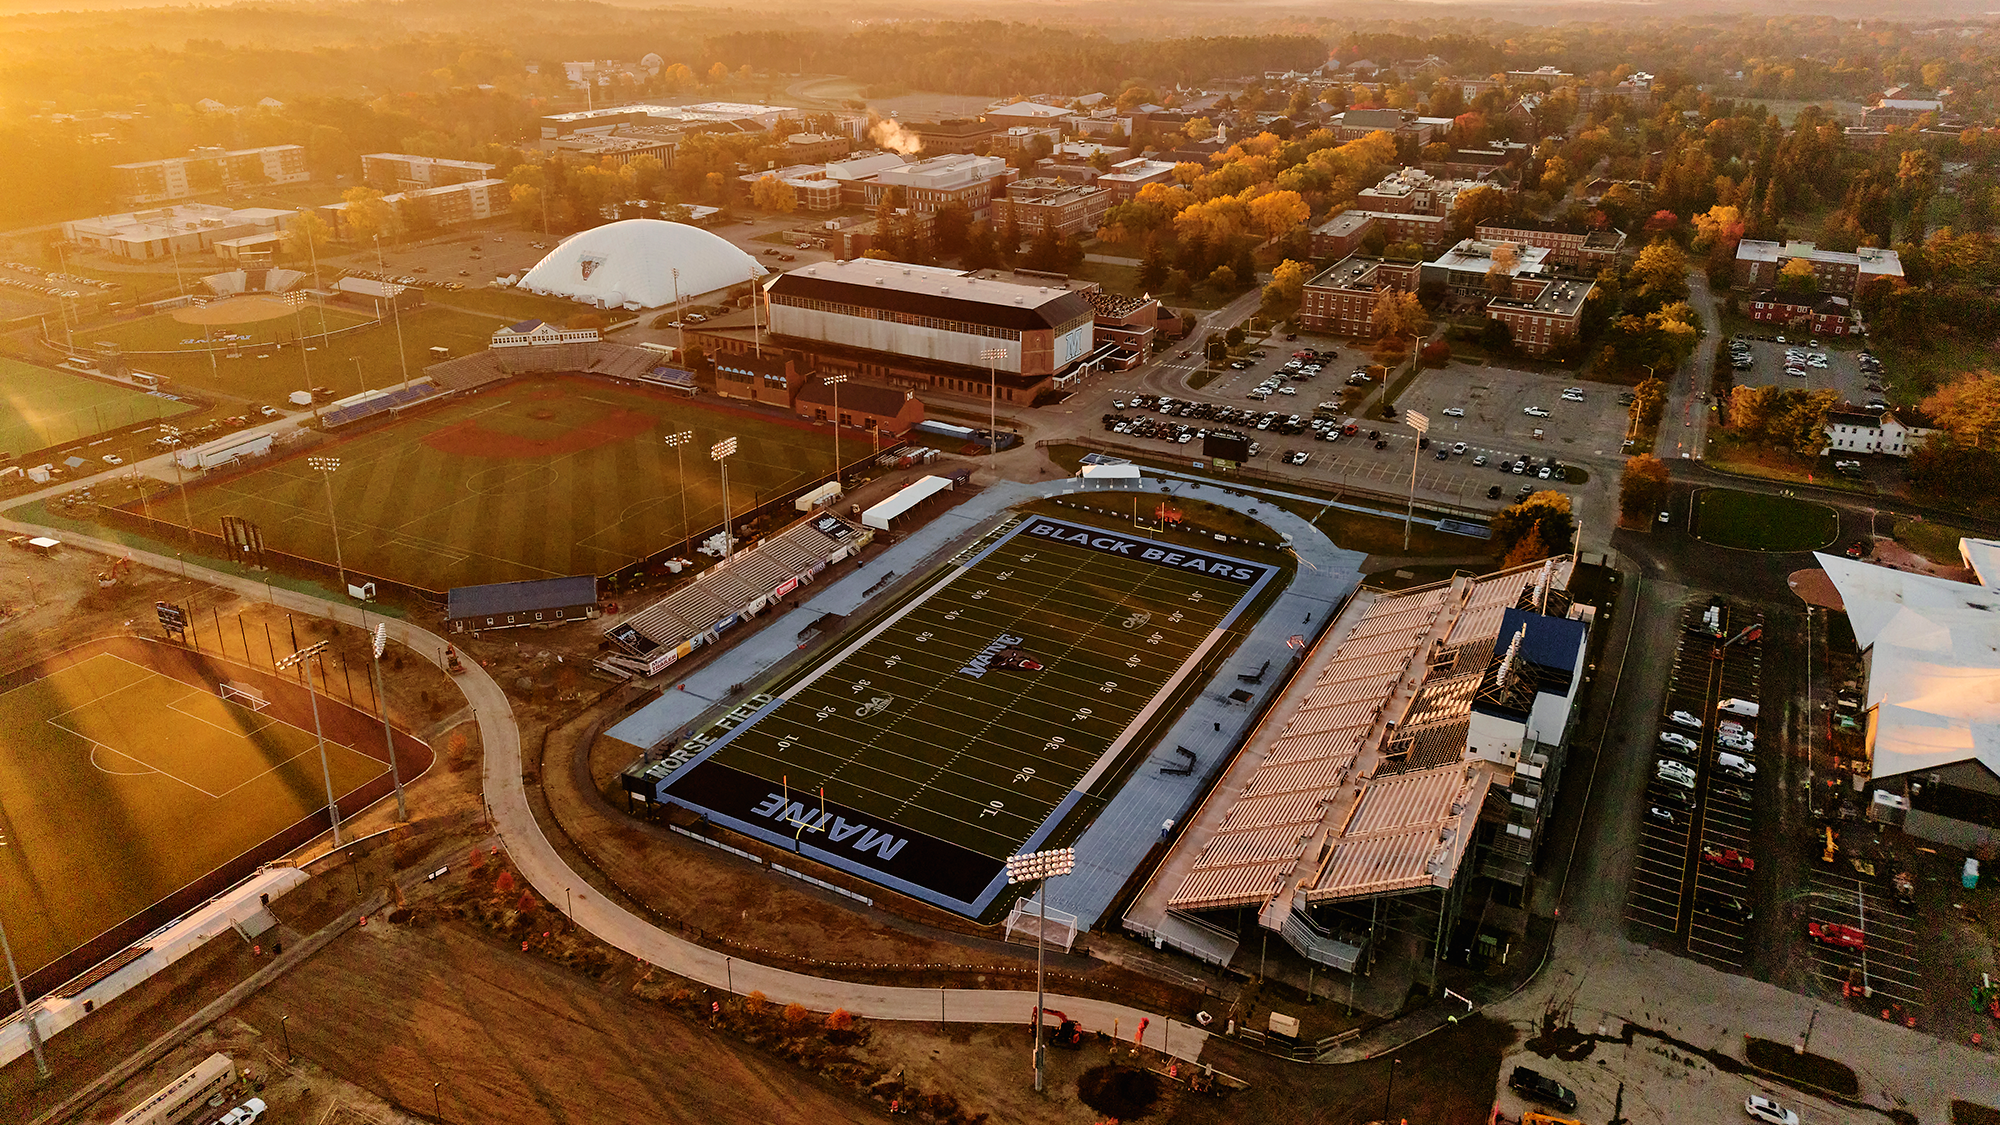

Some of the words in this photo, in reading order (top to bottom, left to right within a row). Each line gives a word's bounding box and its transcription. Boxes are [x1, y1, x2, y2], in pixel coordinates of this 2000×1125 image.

[1030, 524, 1137, 555] BLACK
[1140, 548, 1254, 580] BEARS
[915, 632, 933, 642] 50
[1147, 633, 1163, 645] 30
[885, 655, 901, 667] 40
[959, 633, 1023, 679] MAINE
[1125, 657, 1141, 668] 40
[852, 679, 871, 691] 30
[1100, 681, 1117, 694] 50
[816, 706, 836, 719] 20
[1075, 708, 1092, 720] 40
[645, 733, 718, 779] MORSE
[715, 694, 773, 730] FIELD
[778, 734, 799, 748] 10
[1045, 736, 1065, 750] 30
[1015, 767, 1036, 782] 20
[983, 800, 1004, 816] 10
[750, 793, 908, 861] MAINE
